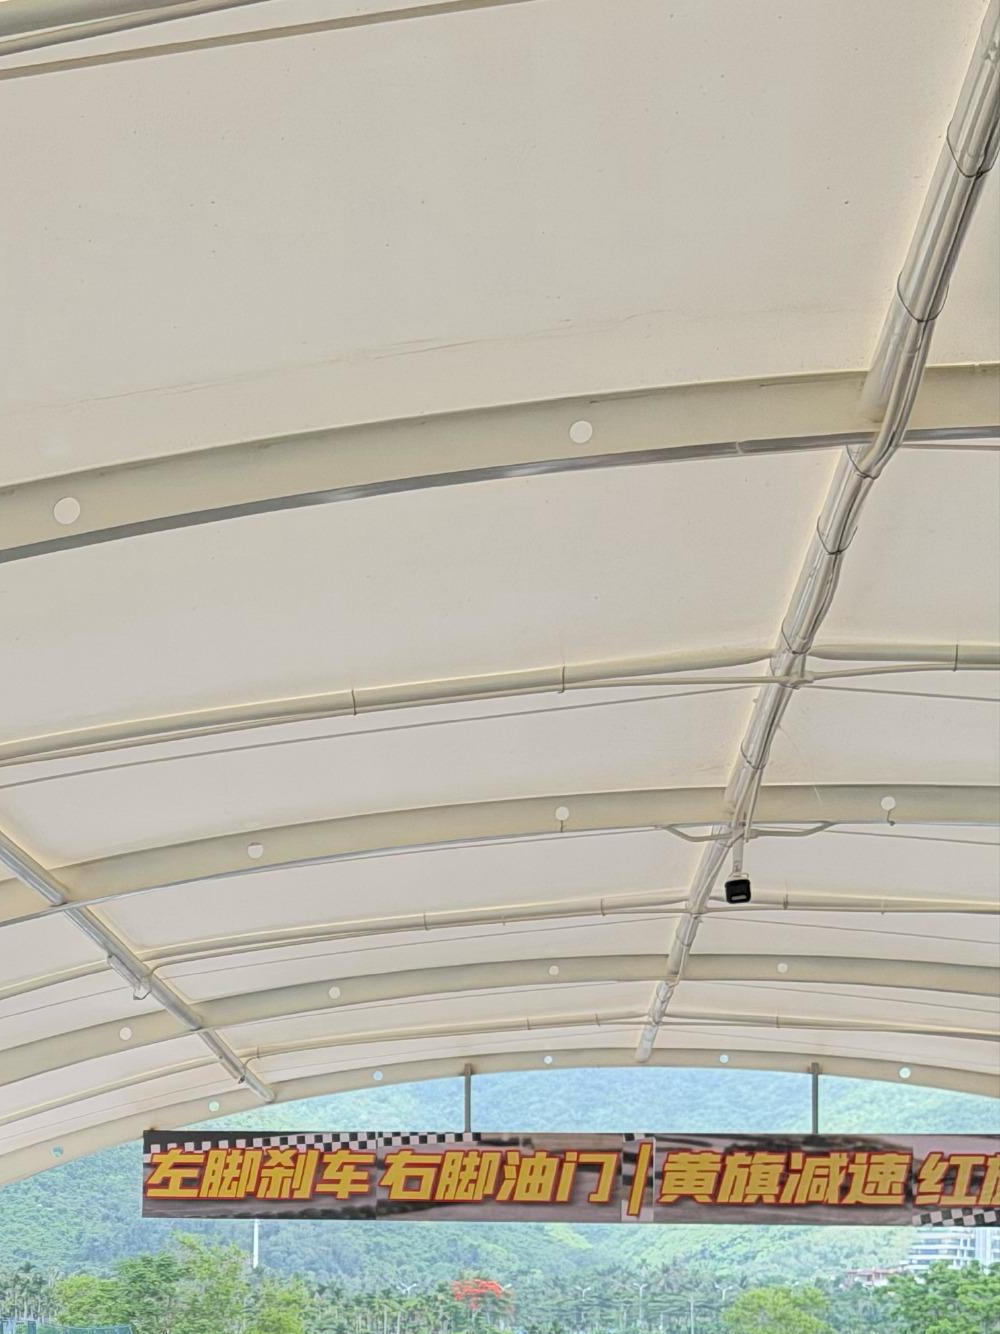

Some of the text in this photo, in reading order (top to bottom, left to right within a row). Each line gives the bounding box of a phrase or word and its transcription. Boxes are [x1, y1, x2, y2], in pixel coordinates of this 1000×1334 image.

[145, 1147, 1000, 1207] 左脚刹车 右脚油门 黄旗减速 红
